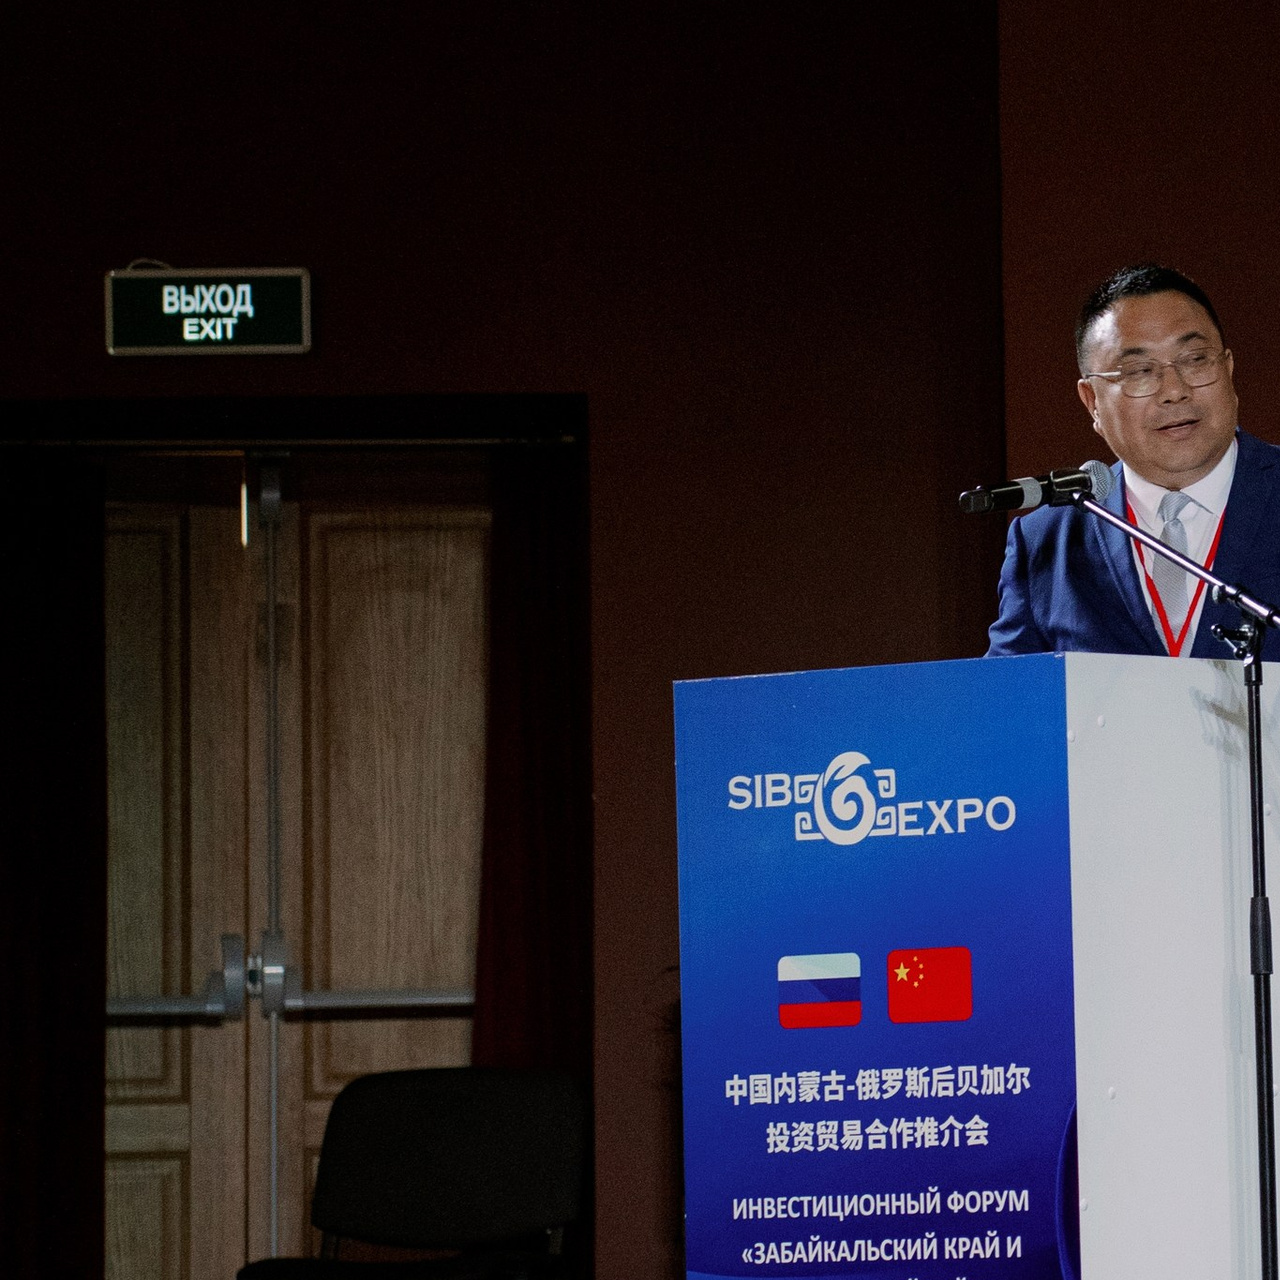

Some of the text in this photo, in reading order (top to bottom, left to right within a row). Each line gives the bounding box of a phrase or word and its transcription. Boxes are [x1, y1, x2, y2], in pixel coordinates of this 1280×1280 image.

[162, 283, 254, 317] ВЫХОД
[182, 318, 238, 340] EXIT
[727, 773, 1017, 837] SIB EXPO
[725, 1063, 1030, 1106] 中国内蒙古-俄罗斯后贝加尔
[766, 1114, 989, 1154] 投资贸易合作推介会
[732, 1185, 1029, 1221] ИНВЕСТИЦИОННЫЙ ФОРУМ
[741, 1230, 1022, 1265] «ЗАБАЙКАЛЬСКИЙ КРАЙ И
